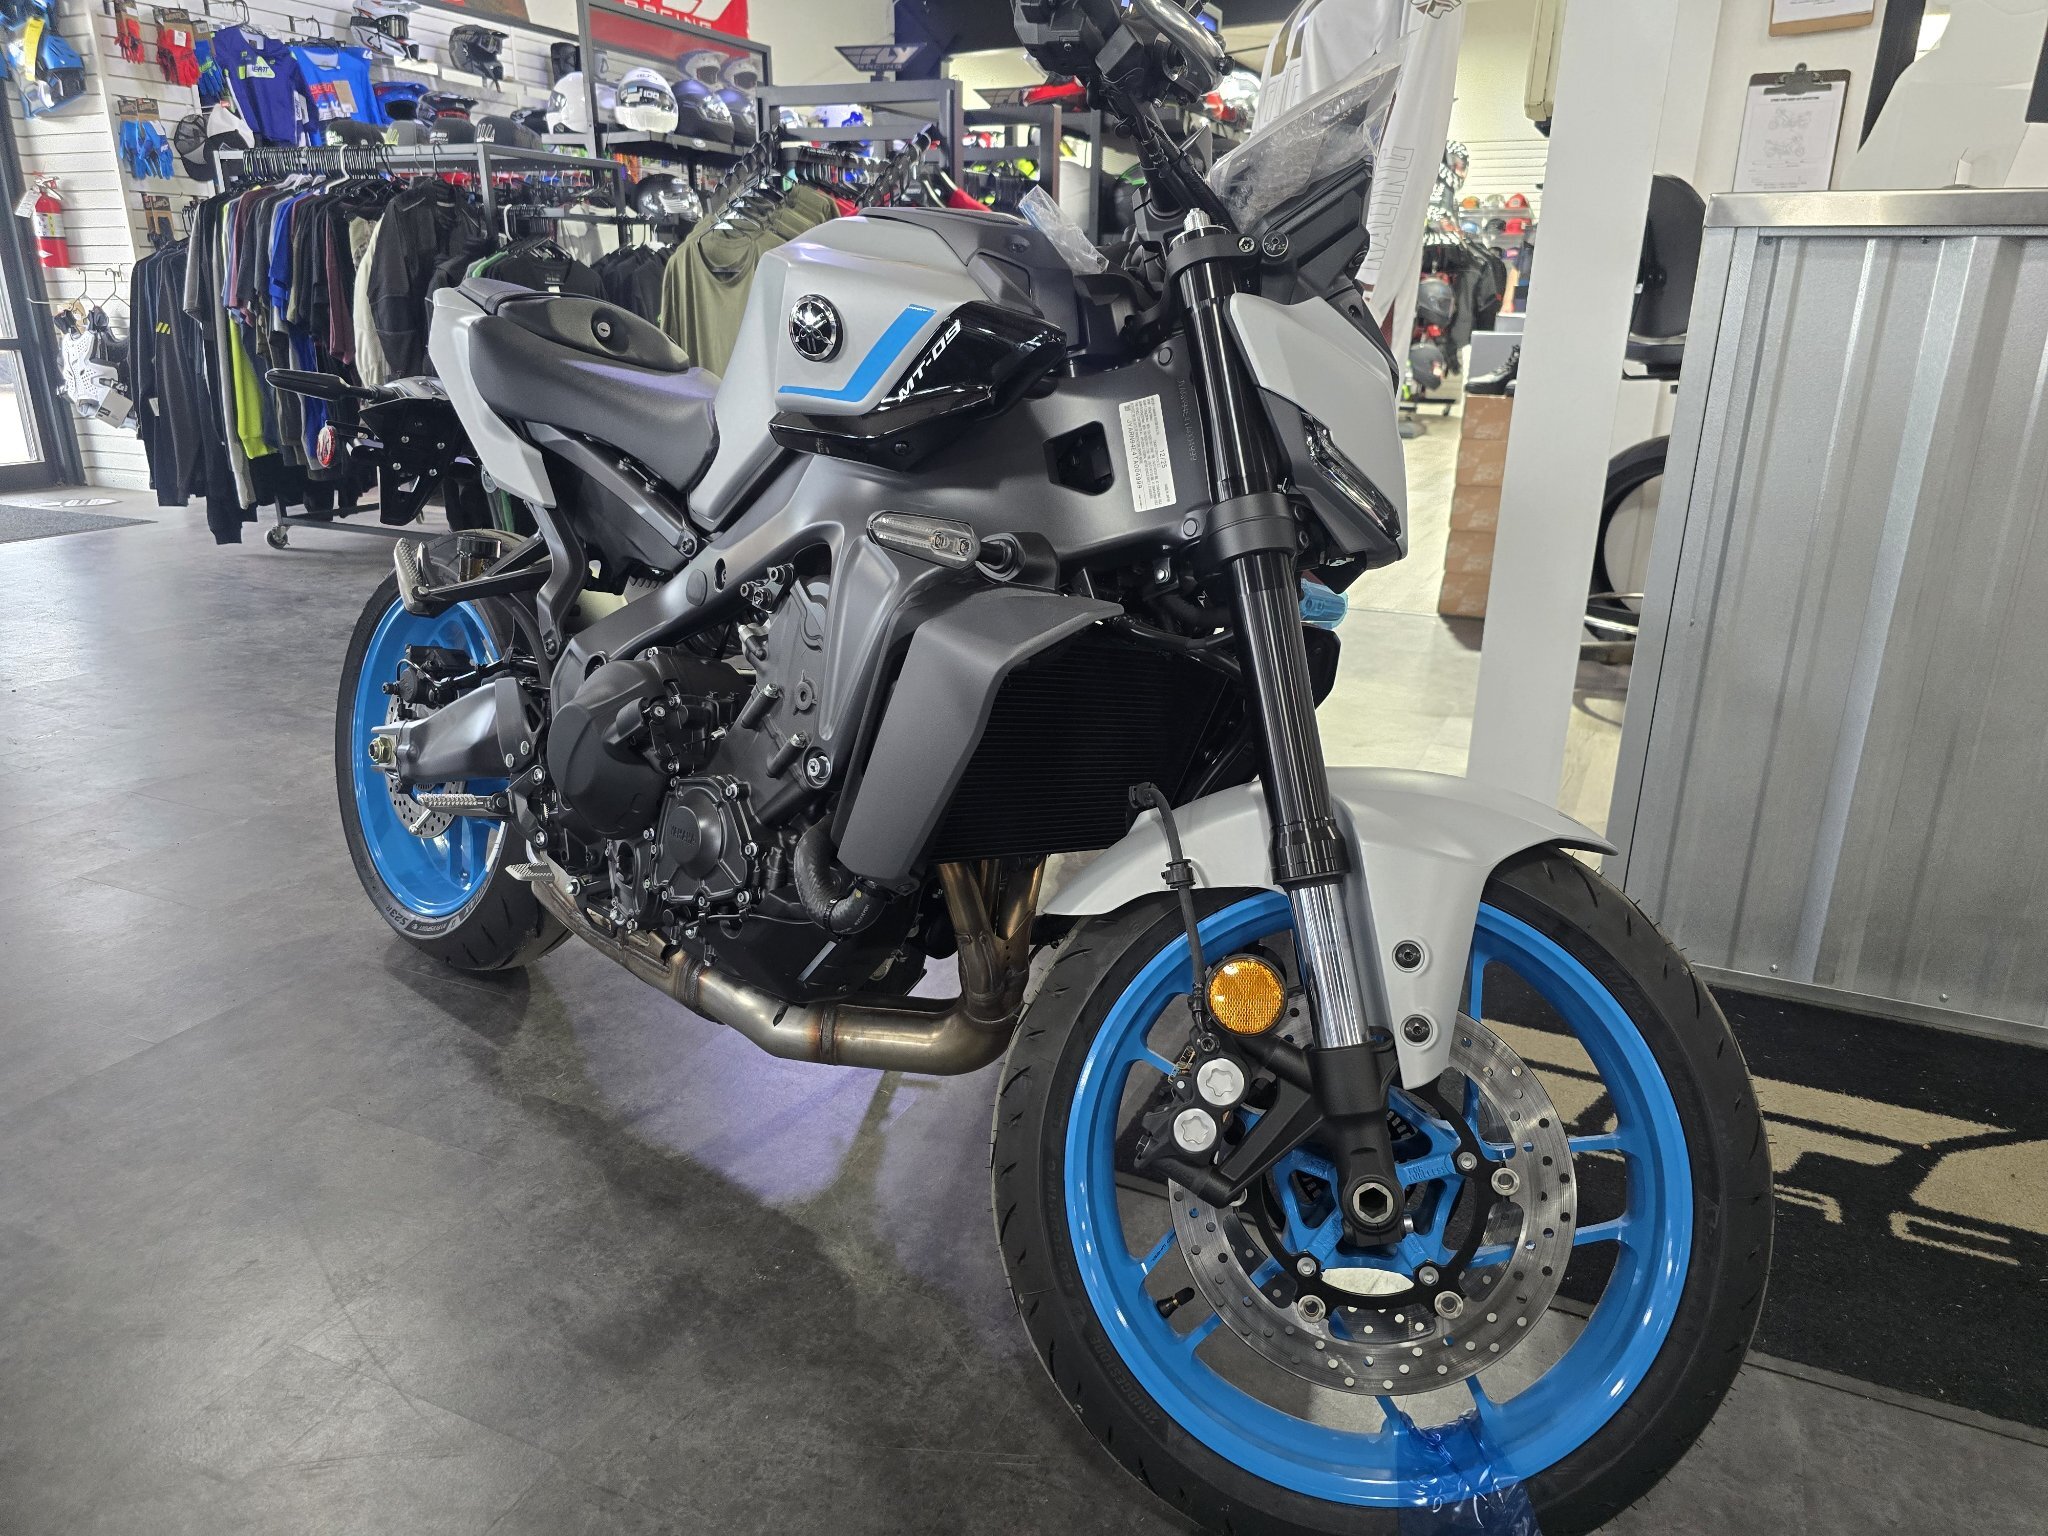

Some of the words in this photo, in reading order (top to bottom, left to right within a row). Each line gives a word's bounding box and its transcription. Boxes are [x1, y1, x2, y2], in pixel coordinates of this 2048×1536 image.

[857, 47, 919, 64] FLY
[898, 318, 961, 403] MT-09
[1159, 448, 1168, 469] 12/25
